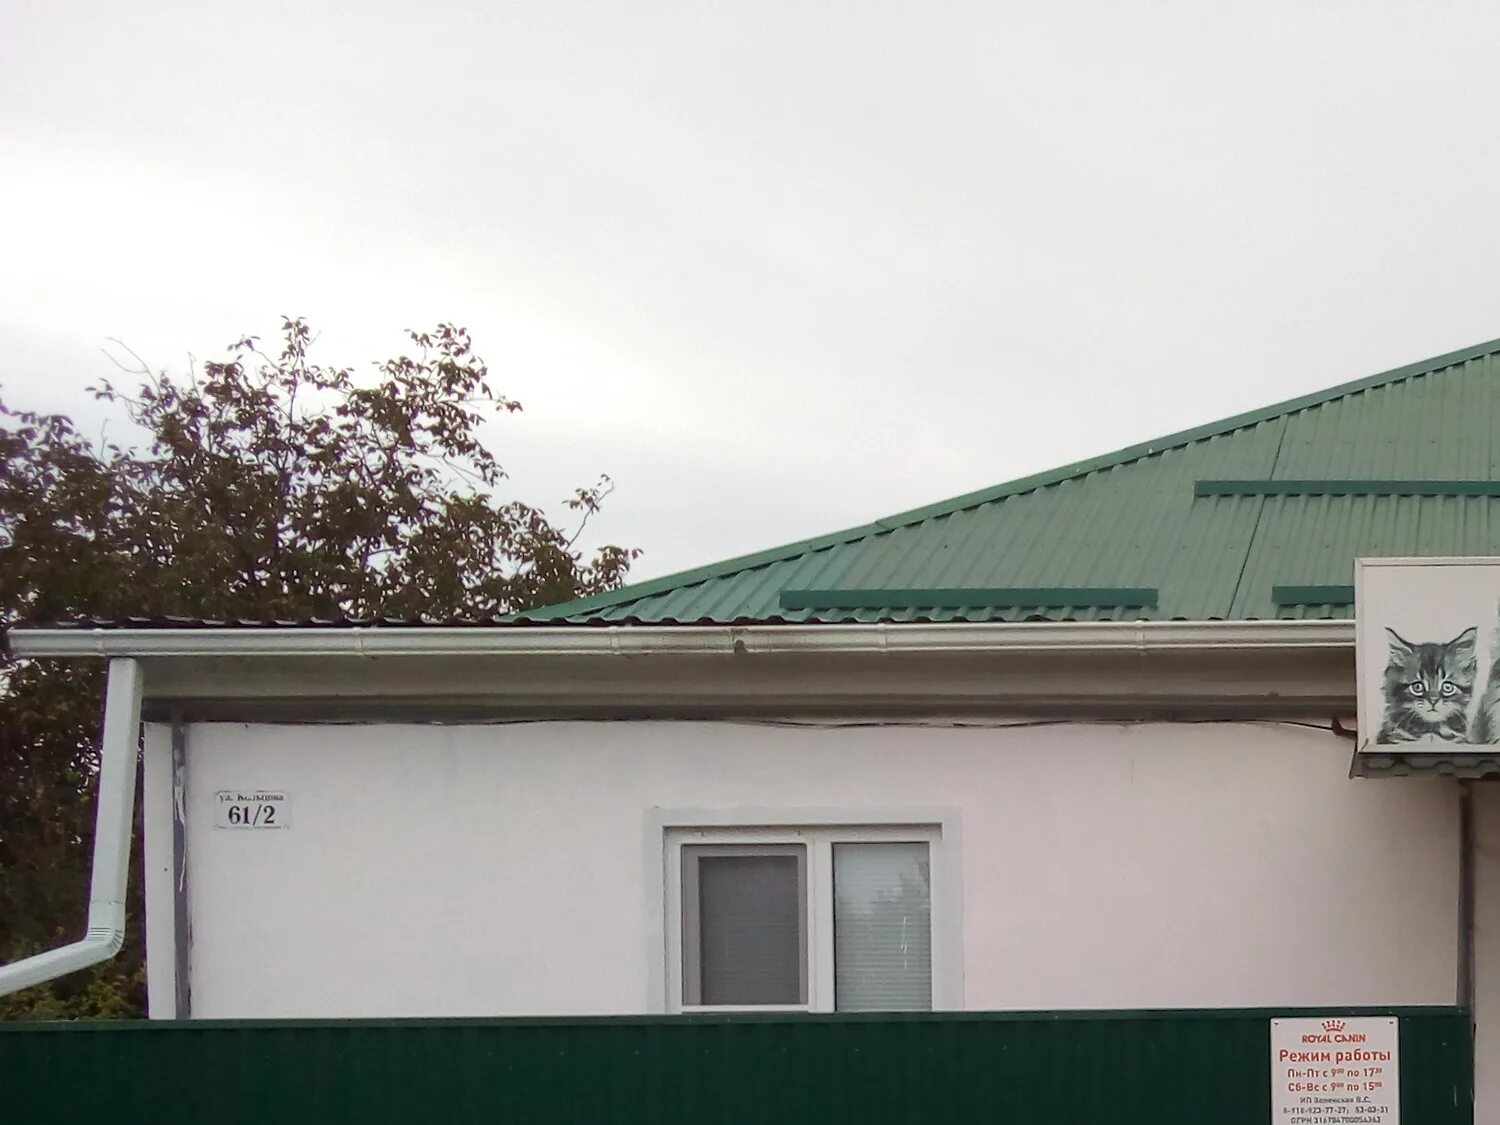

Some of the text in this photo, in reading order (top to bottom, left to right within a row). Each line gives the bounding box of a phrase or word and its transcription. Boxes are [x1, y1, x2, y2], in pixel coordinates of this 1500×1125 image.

[228, 804, 275, 826] 61/2
[1302, 1034, 1366, 1043] ROYAL CANIN
[1280, 1048, 1391, 1064] Режим работы
[1287, 1068, 1319, 1078] Пн-Пт
[1288, 1082, 1319, 1092] Сб-Вс
[1347, 1083, 1359, 1091] по
